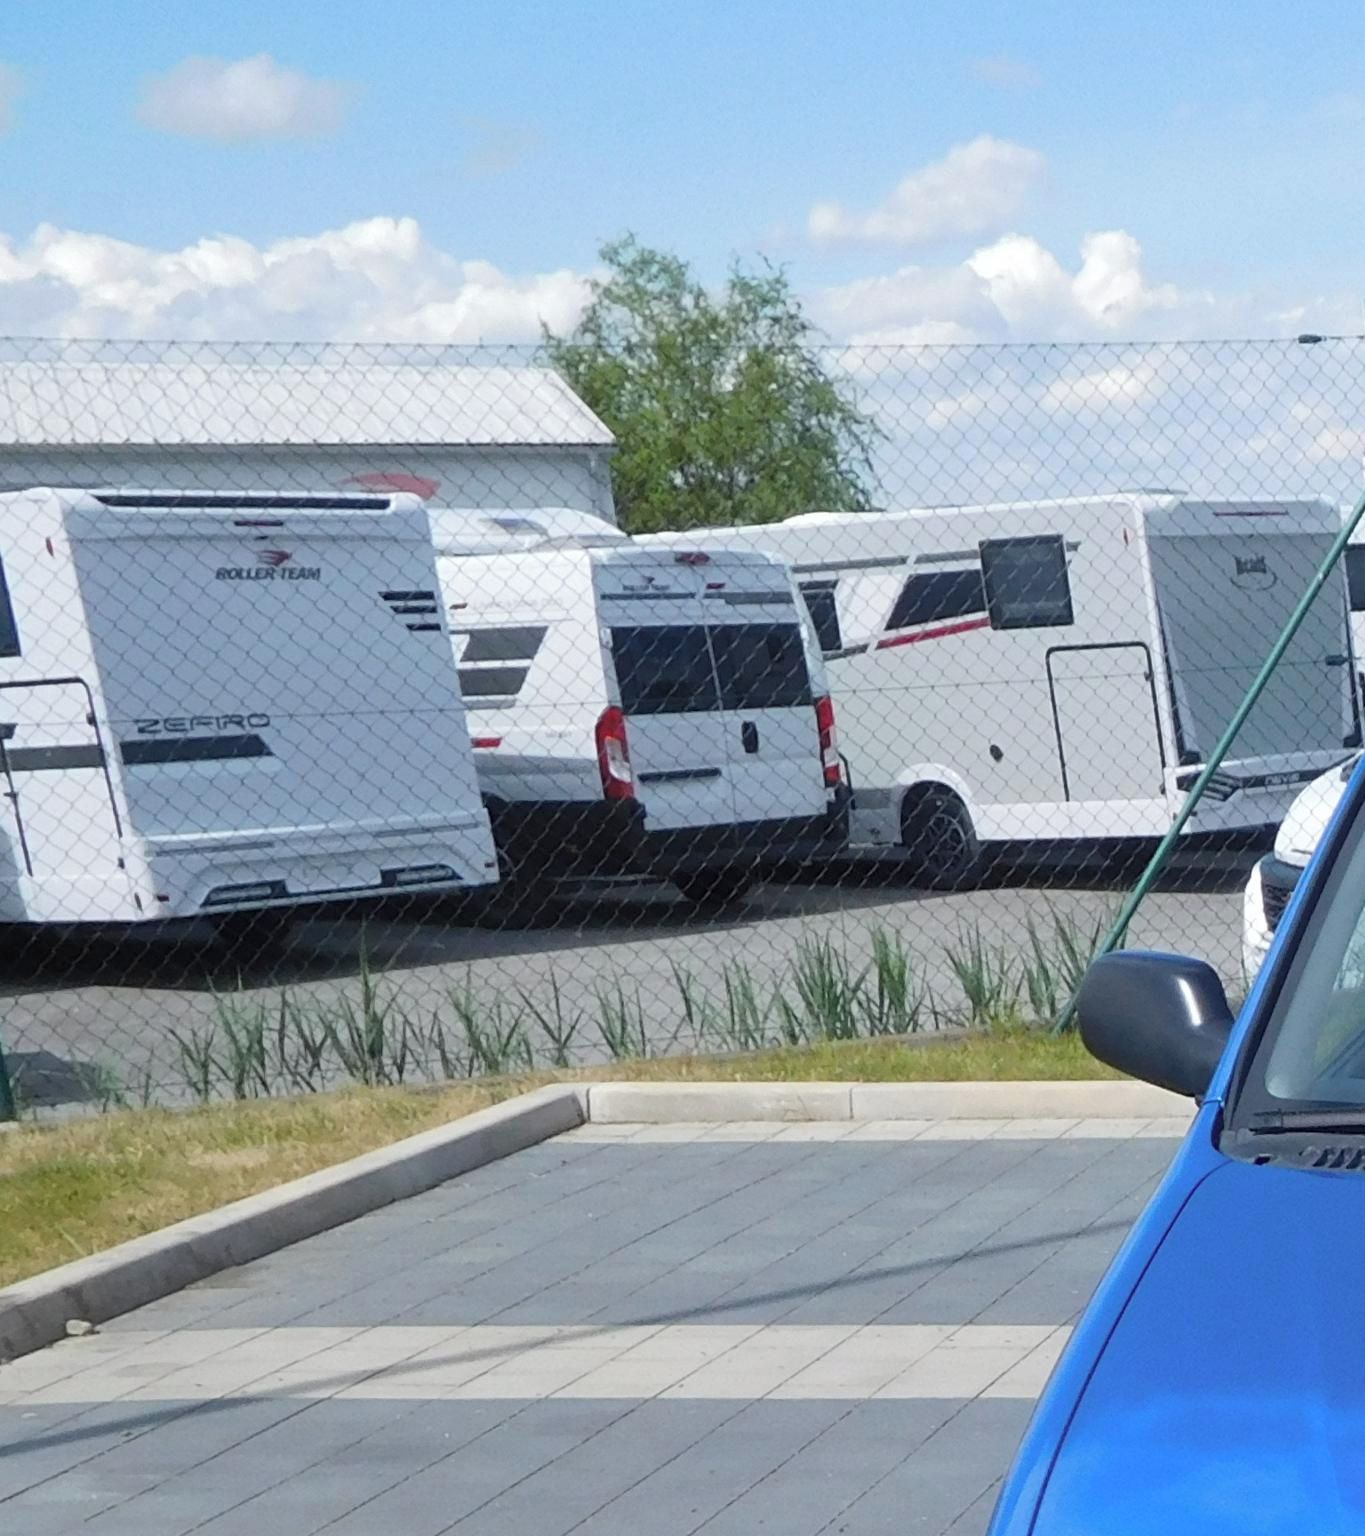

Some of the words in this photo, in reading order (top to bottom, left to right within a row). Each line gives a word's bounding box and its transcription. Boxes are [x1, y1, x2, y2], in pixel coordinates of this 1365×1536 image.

[215, 567, 275, 580] ROLLER
[281, 567, 320, 581] TEAM
[134, 713, 270, 734] ZEFIRO
